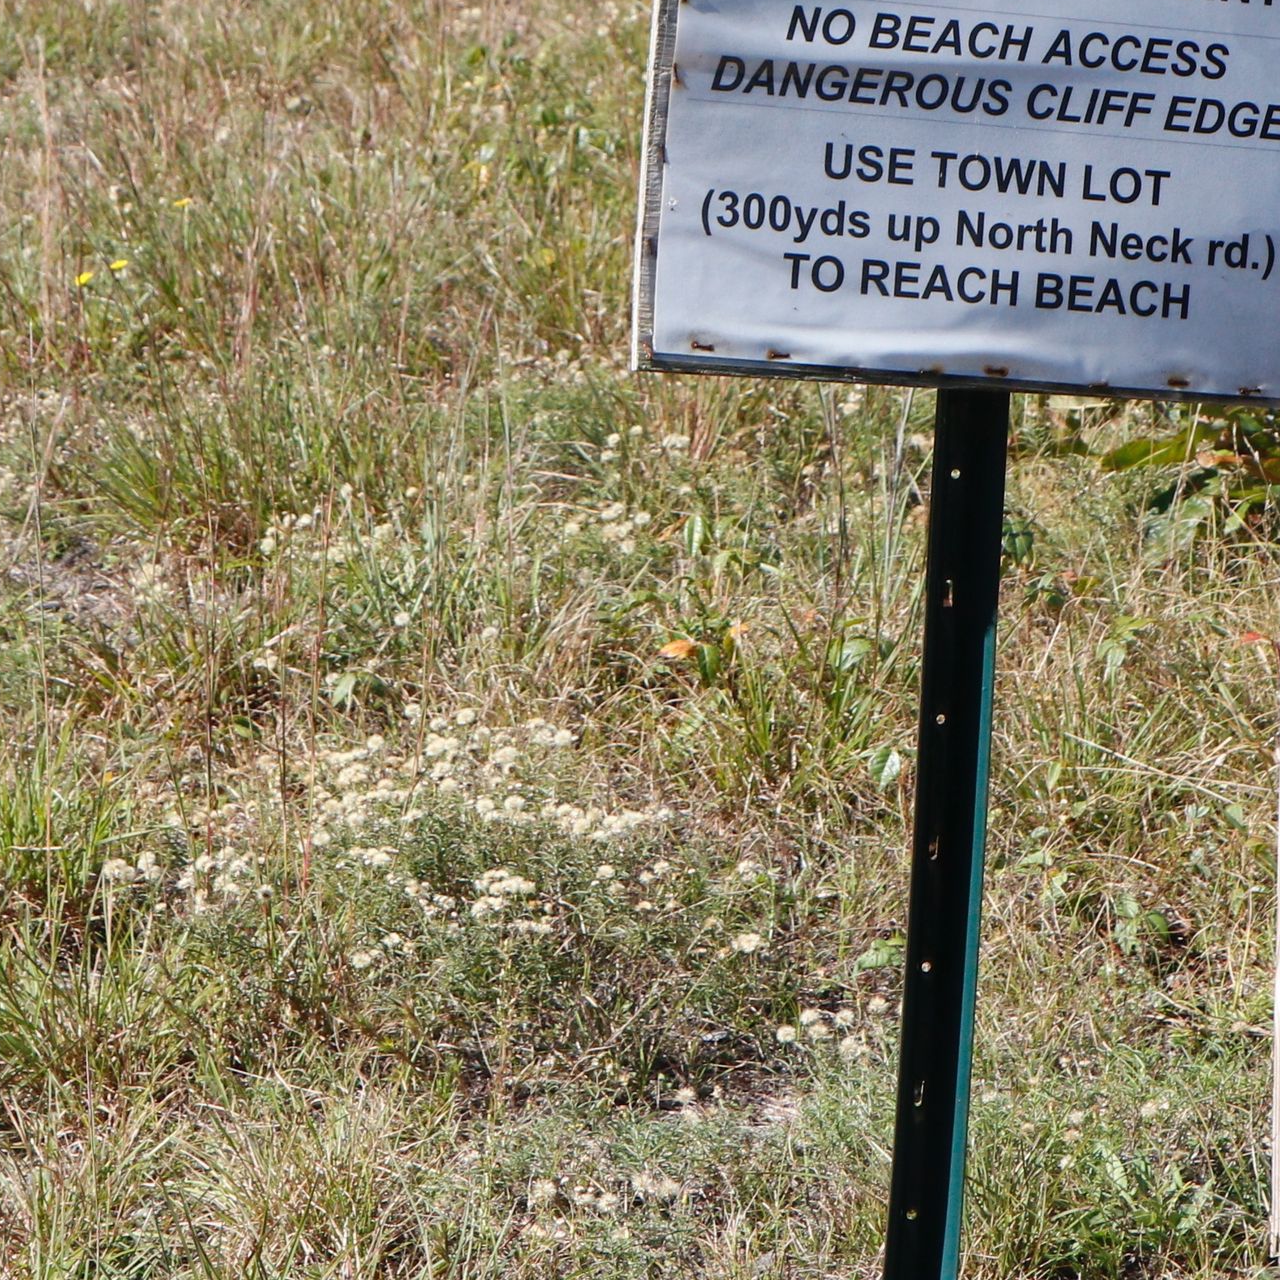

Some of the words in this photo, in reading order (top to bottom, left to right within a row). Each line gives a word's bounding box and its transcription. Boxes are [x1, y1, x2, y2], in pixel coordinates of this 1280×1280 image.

[786, 4, 856, 46] NO
[868, 12, 1034, 62] BEACH
[1041, 29, 1230, 80] ACCESS
[710, 52, 1012, 117] DANGEROUS
[1026, 83, 1156, 128] CLIFF
[824, 142, 916, 186] USE
[930, 151, 1067, 198] TOWN
[1082, 164, 1171, 206] LOT
[701, 189, 871, 244] (300yds
[887, 213, 940, 252] up
[956, 209, 1073, 255] North
[1089, 220, 1195, 265] Neck
[1207, 232, 1276, 281] rd.)
[783, 252, 845, 293] TO
[860, 258, 1020, 307] REACH
[1034, 272, 1191, 321] BEACH
